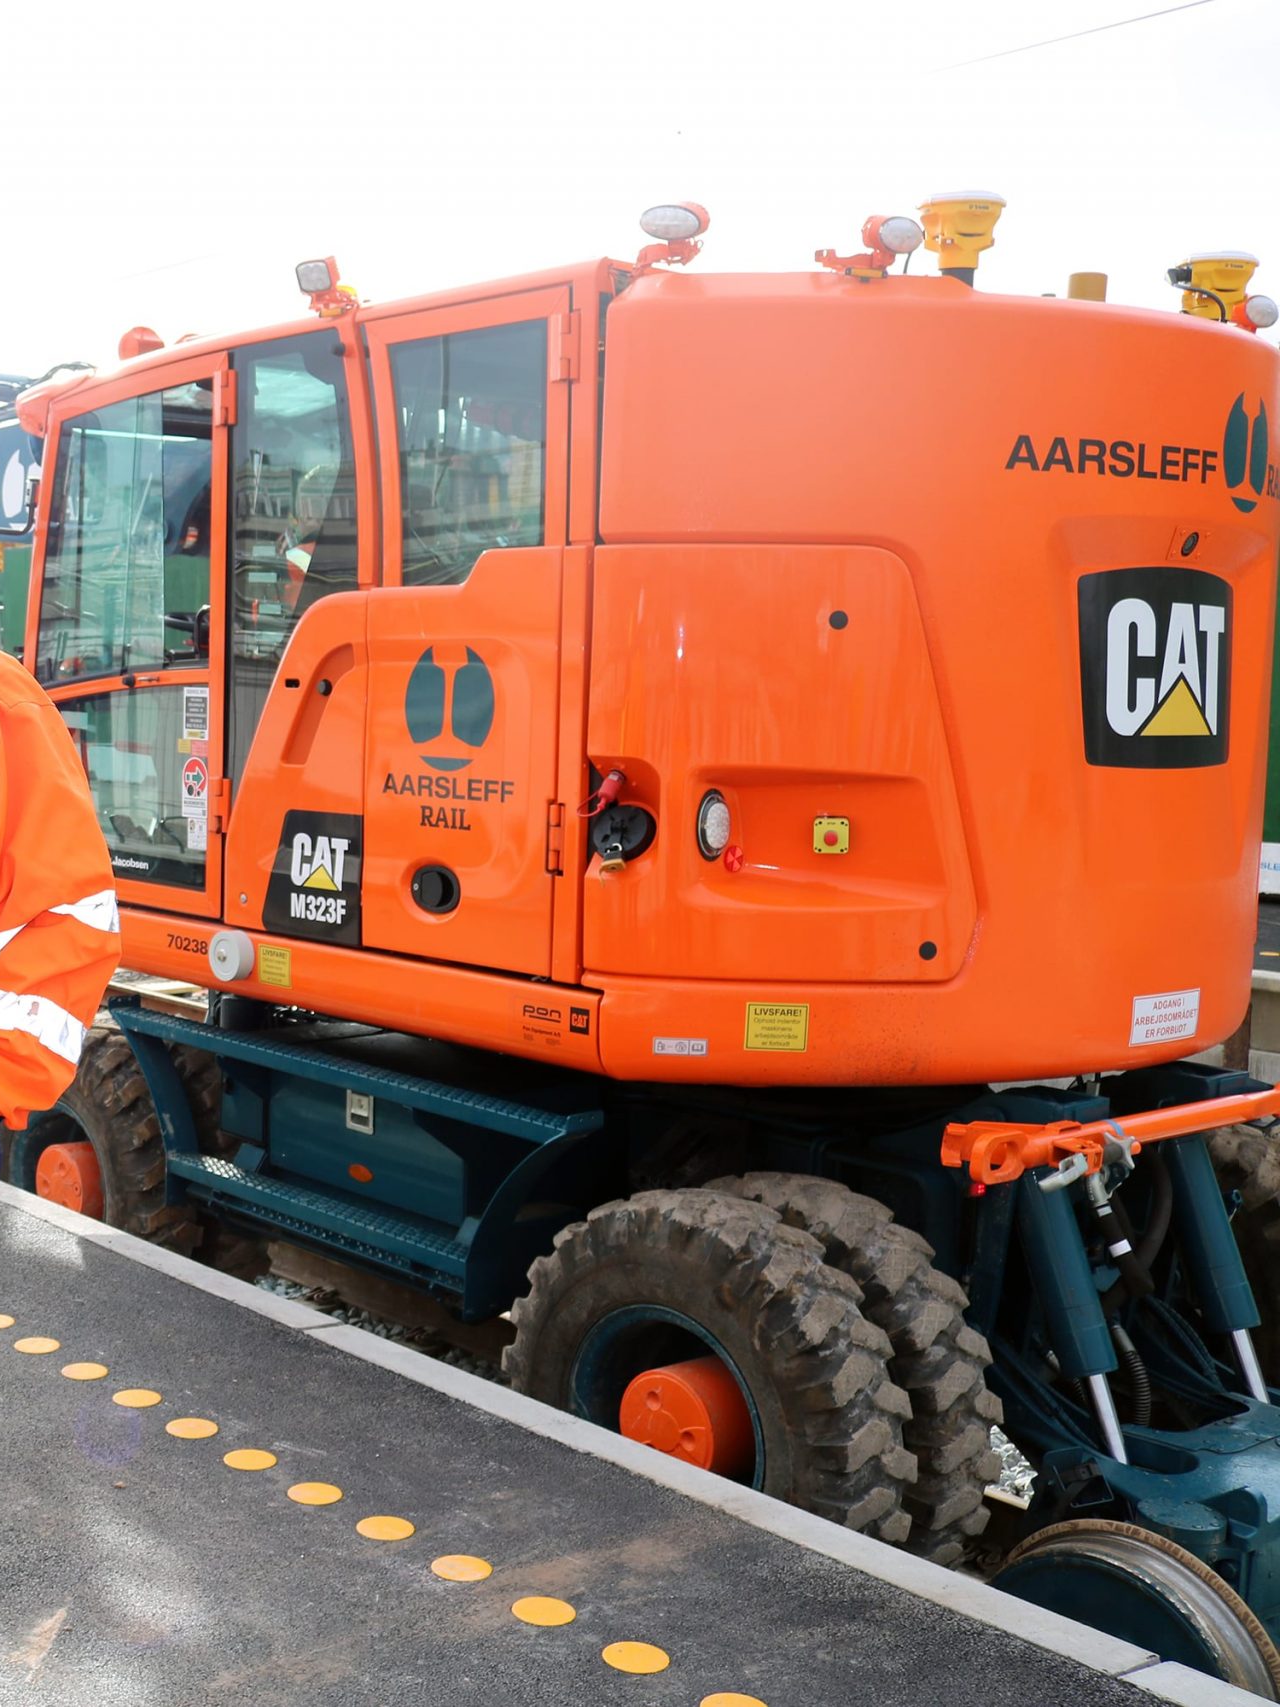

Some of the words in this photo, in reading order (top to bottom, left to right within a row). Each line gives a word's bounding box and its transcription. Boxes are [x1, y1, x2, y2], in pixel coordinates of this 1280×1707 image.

[1005, 434, 1218, 484] AARSLEFF
[1106, 598, 1225, 737] CAT
[382, 772, 515, 803] AARSLEFF
[420, 805, 472, 831] RAIL
[111, 855, 149, 870] Jacobsen
[290, 832, 349, 892] CAT
[290, 892, 346, 924] M323F
[167, 933, 208, 955] 70238
[754, 1007, 801, 1017] LIVSFARE!
[1152, 998, 1181, 1010] ADGANG
[572, 1013, 589, 1028] CAT
[1145, 1028, 1155, 1038] ER
[1156, 1023, 1187, 1036] FORBUDT
